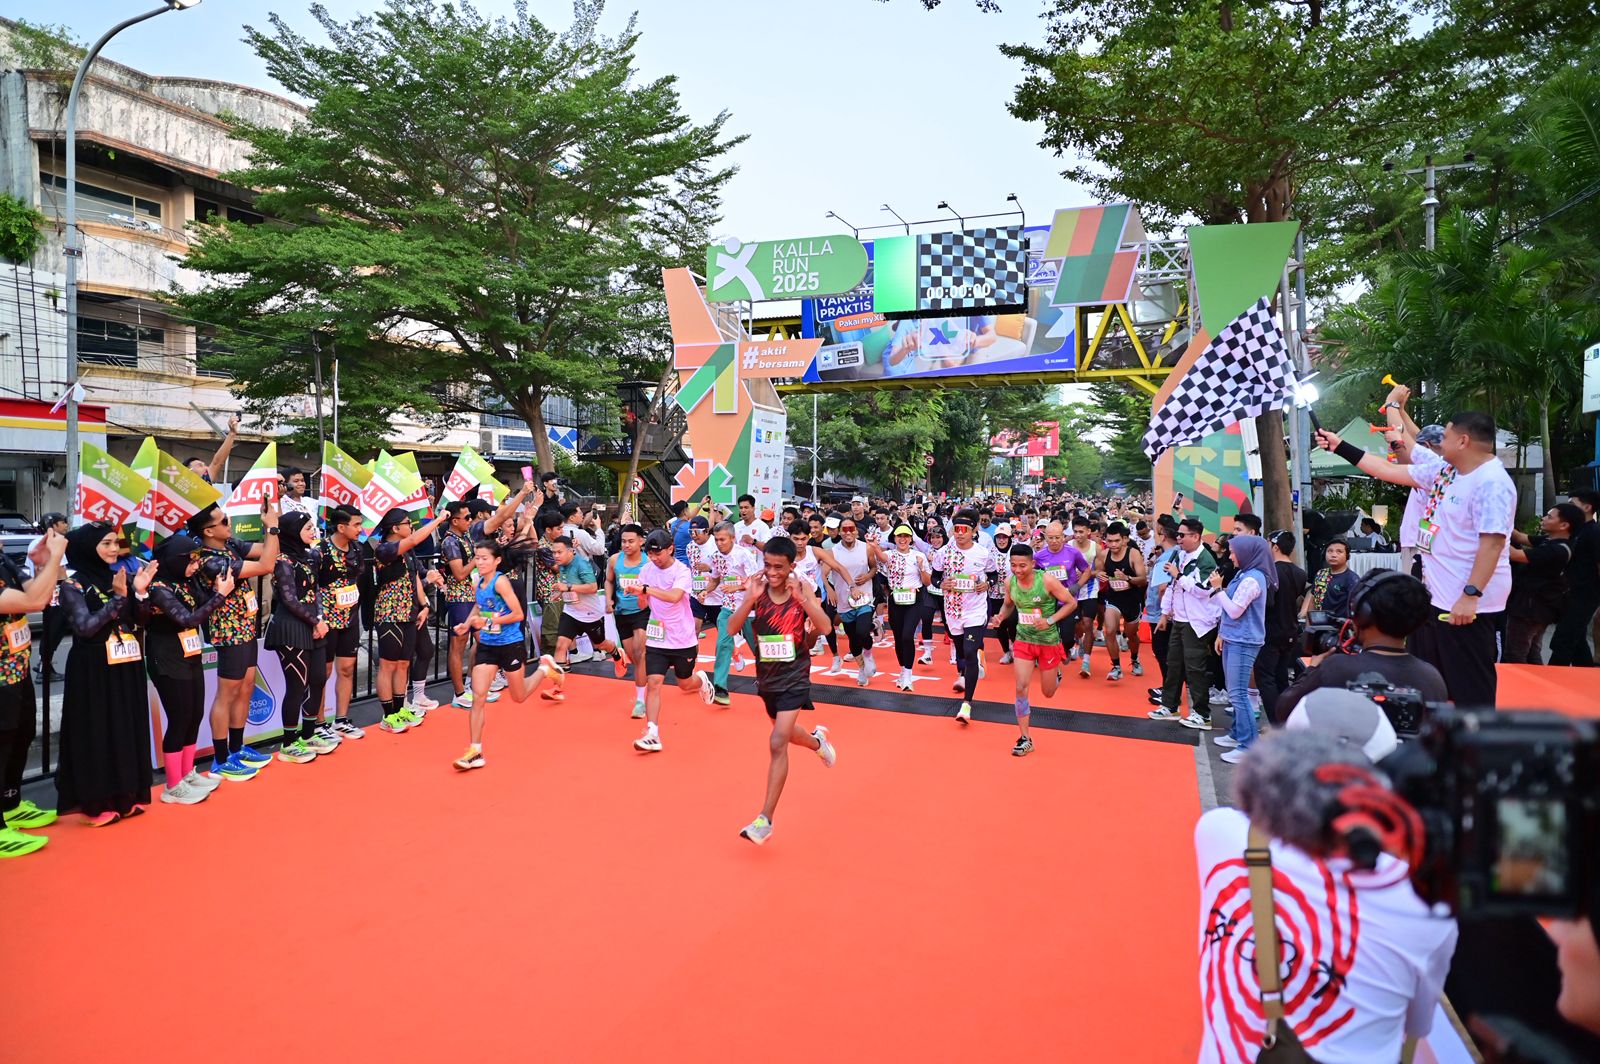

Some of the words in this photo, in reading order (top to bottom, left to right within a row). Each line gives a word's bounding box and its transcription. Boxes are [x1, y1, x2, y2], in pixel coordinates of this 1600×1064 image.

[773, 239, 834, 259] KALLA
[772, 257, 809, 275] RUN
[772, 272, 820, 294] 2025
[926, 283, 991, 300] 00:00:00
[820, 300, 872, 318] PRAKTIS
[839, 318, 860, 328] Pakai
[758, 359, 806, 369] bersama
[449, 475, 469, 495] 35
[340, 590, 358, 603] PACER
[765, 644, 787, 655] 2876
